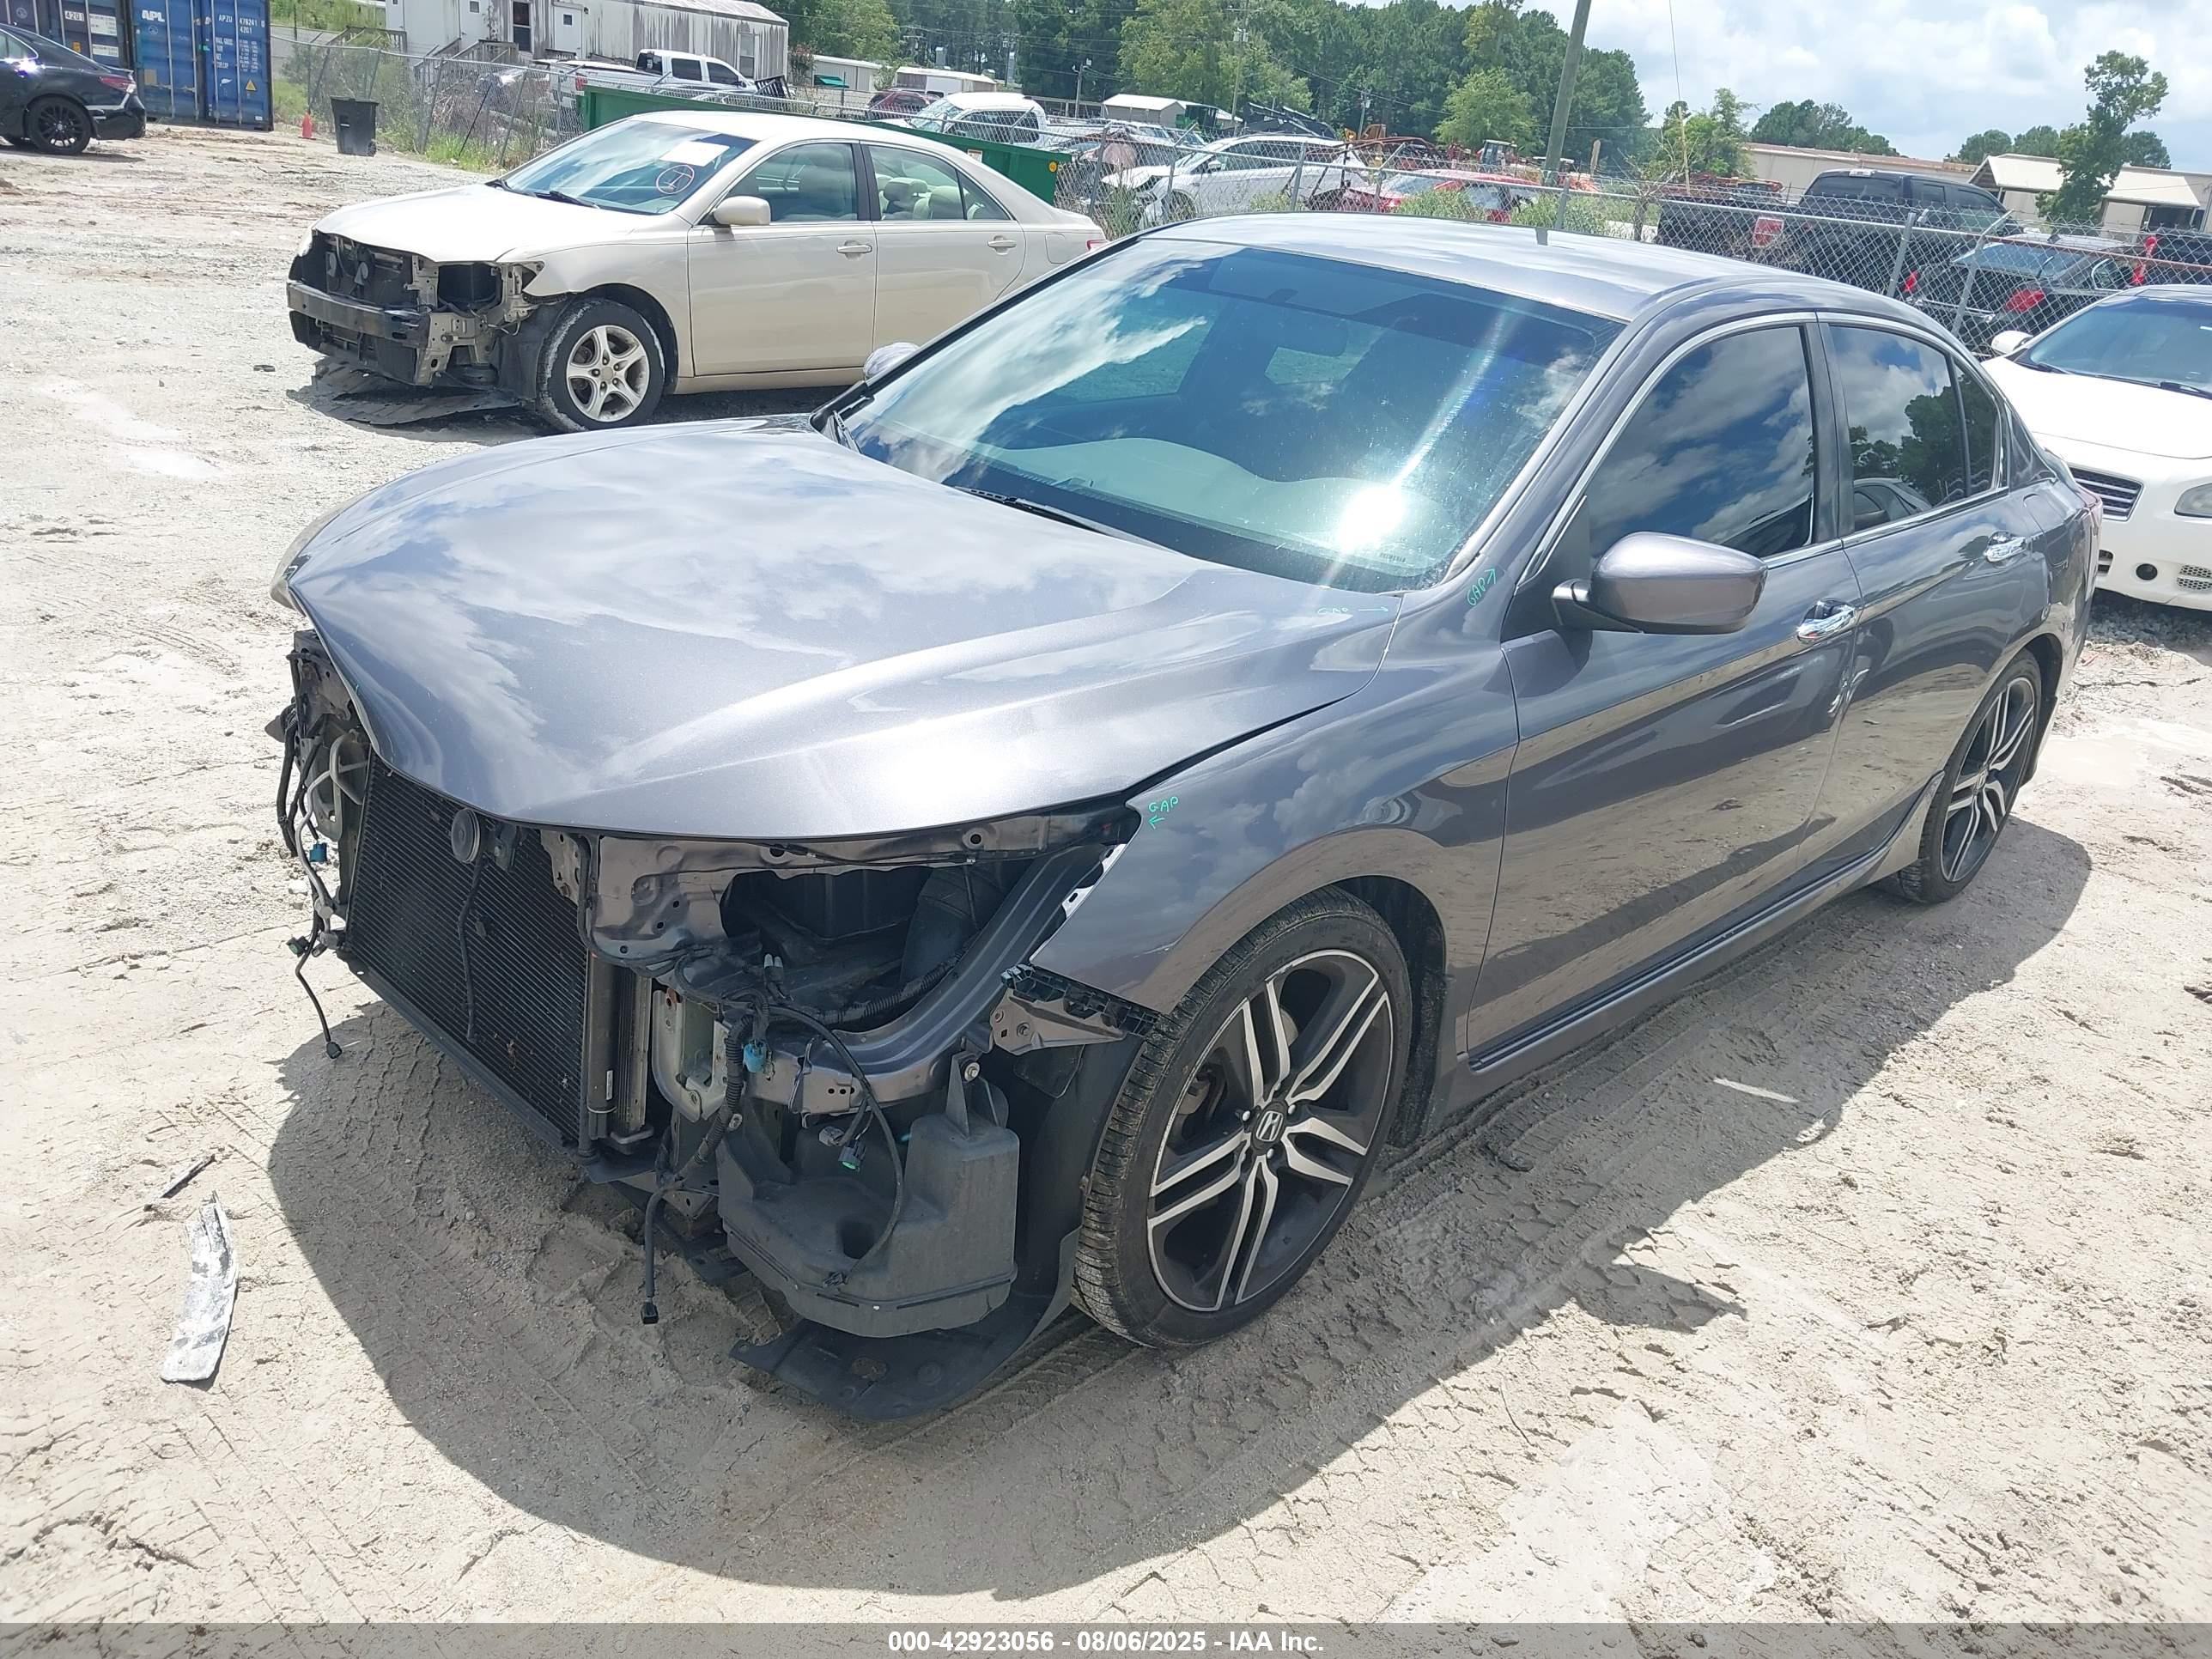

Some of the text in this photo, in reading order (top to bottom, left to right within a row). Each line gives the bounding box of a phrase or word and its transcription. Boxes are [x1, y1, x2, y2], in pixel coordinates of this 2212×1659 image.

[142, 9, 166, 22] APL
[1467, 577, 1486, 606] GAP
[1148, 796, 1179, 812] GAP
